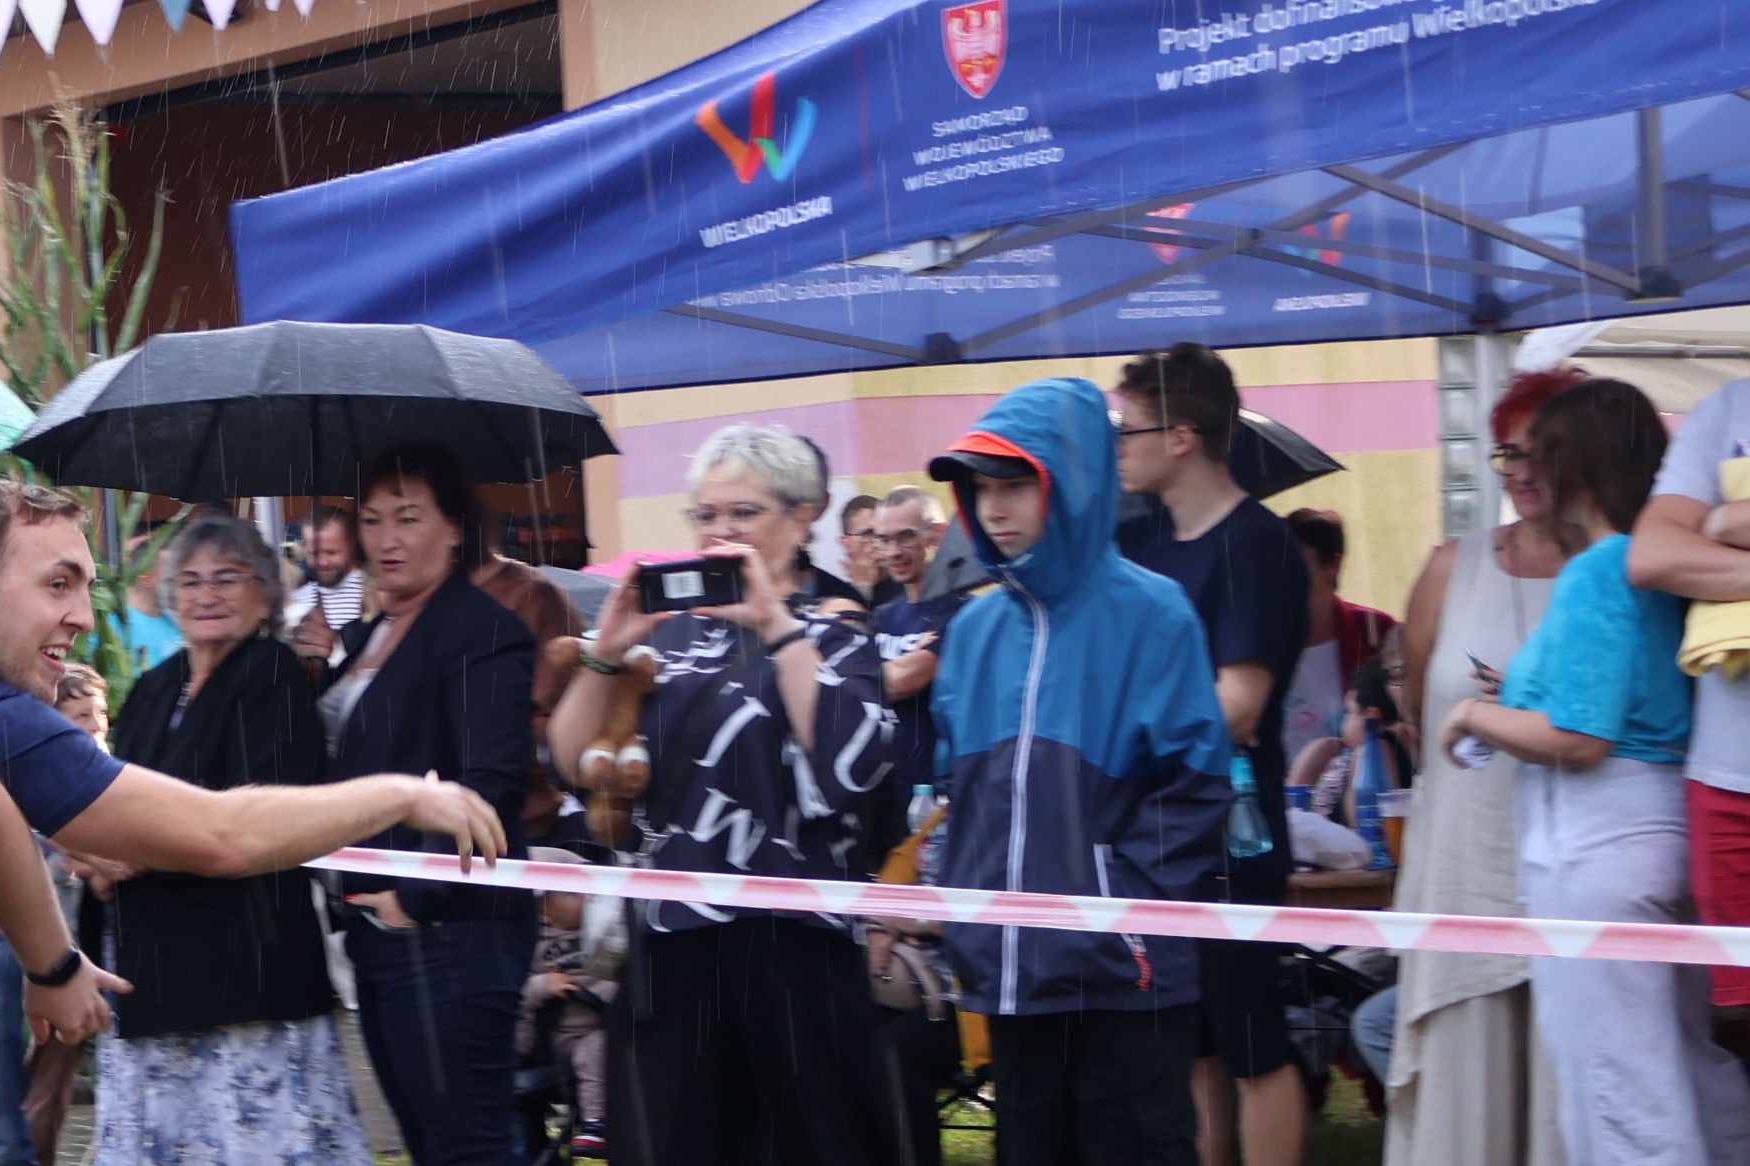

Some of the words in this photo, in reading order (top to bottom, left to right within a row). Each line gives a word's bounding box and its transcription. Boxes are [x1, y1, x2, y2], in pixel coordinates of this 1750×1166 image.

[1156, 70, 1182, 90] w
[1182, 44, 1277, 86] ramach
[1279, 22, 1409, 72] programu
[1412, 0, 1599, 38] Wielkopo
[1158, 13, 1252, 54] Projekt
[699, 196, 833, 248] WIELKOPOLSKA
